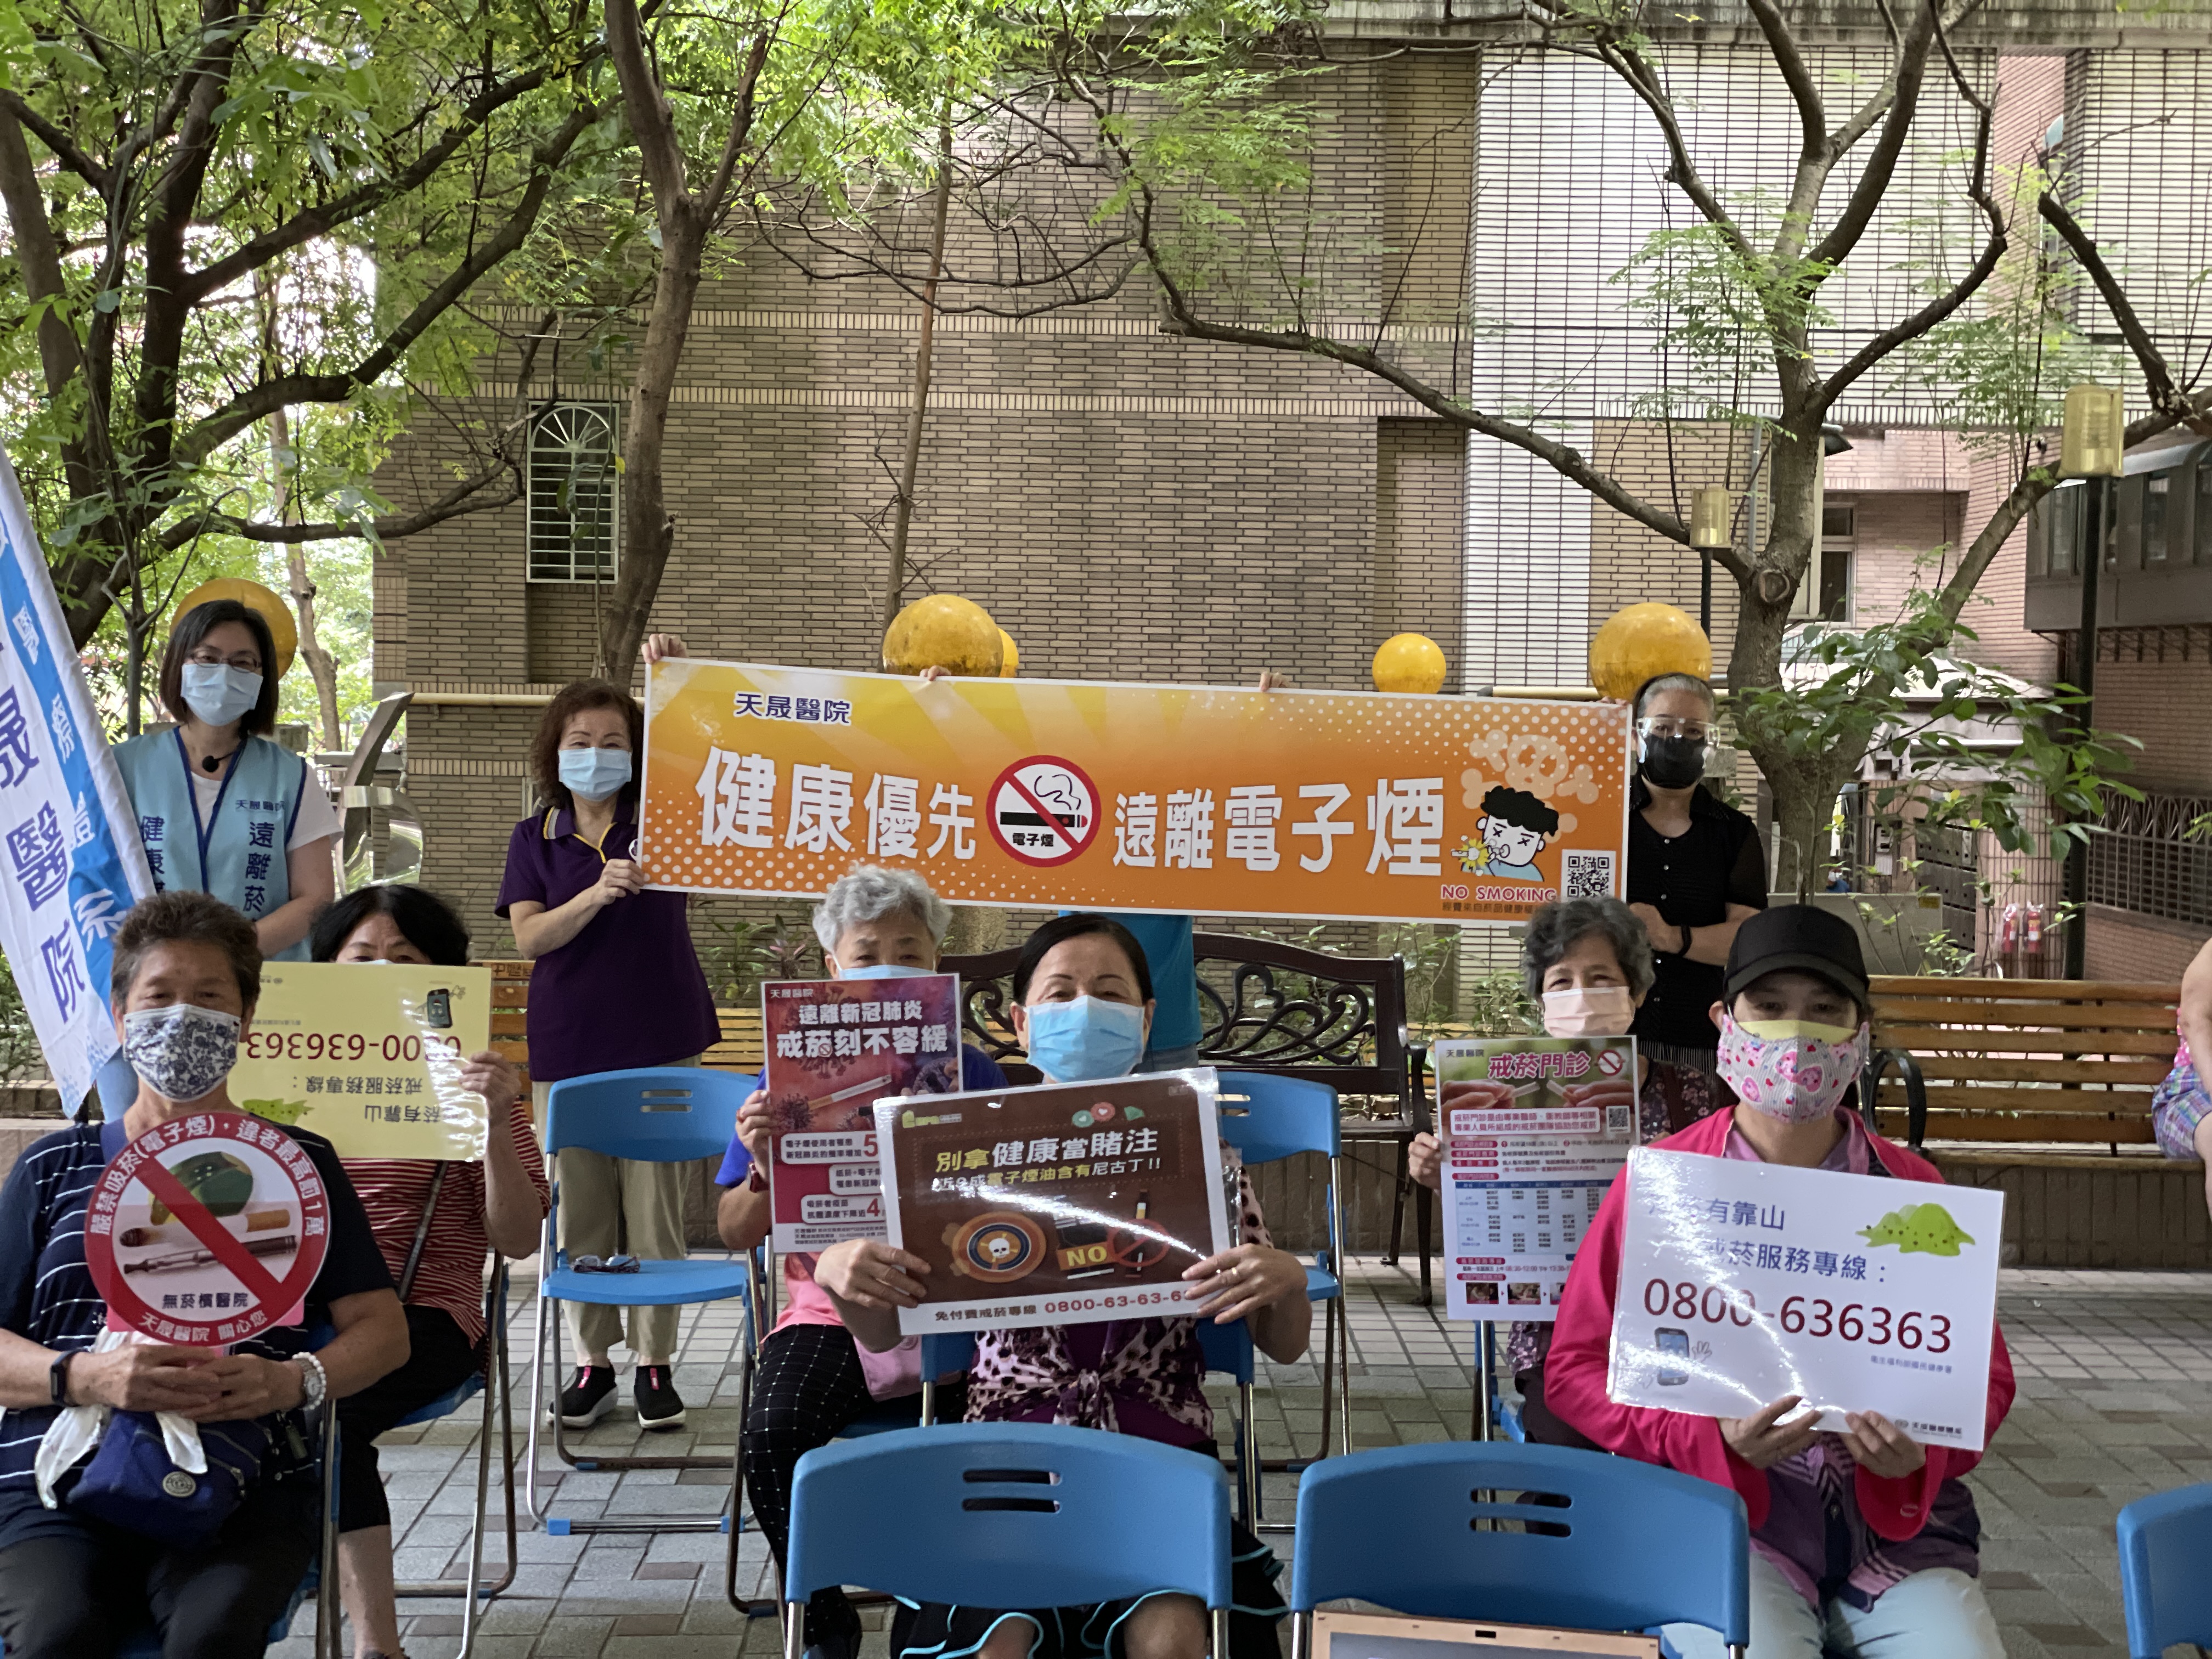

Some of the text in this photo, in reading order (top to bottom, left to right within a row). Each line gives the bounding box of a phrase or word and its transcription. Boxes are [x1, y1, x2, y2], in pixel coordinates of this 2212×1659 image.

[736, 693, 851, 724] 天晟醫院
[696, 746, 976, 860] 健康優先
[1012, 832, 1054, 848] 電子煙
[1113, 777, 1443, 876] 遠離電子煙
[140, 815, 166, 894] 健康
[244, 821, 275, 922] 遠離菸
[1441, 884, 1557, 901] NO SMOKING
[1442, 902, 1534, 913] 經費來自菸品健康福
[770, 989, 813, 998] 天晟醫院
[799, 1000, 922, 1025] 遠離新冠肺炎
[247, 1032, 461, 1062] 000-636363
[777, 1024, 948, 1058] 戒菸刻不容緩
[1446, 1049, 1484, 1058] 天晟醫院
[1488, 1051, 1591, 1079] 戒菸門診
[364, 1104, 460, 1122] 菸有靠山
[935, 1128, 1158, 1173] 別拿健康當賭注
[837, 1179, 880, 1188] 罹患新冠肺
[1067, 1246, 1108, 1267] NO
[162, 1293, 248, 1309] 無菸檳醫院
[935, 1290, 1188, 1322] 免付費戒菸專線 0800-63-63-6
[1644, 1278, 1951, 1353] 0800-636363
[138, 1312, 210, 1342] 天晟醫院
[218, 1309, 268, 1340] 關心您
